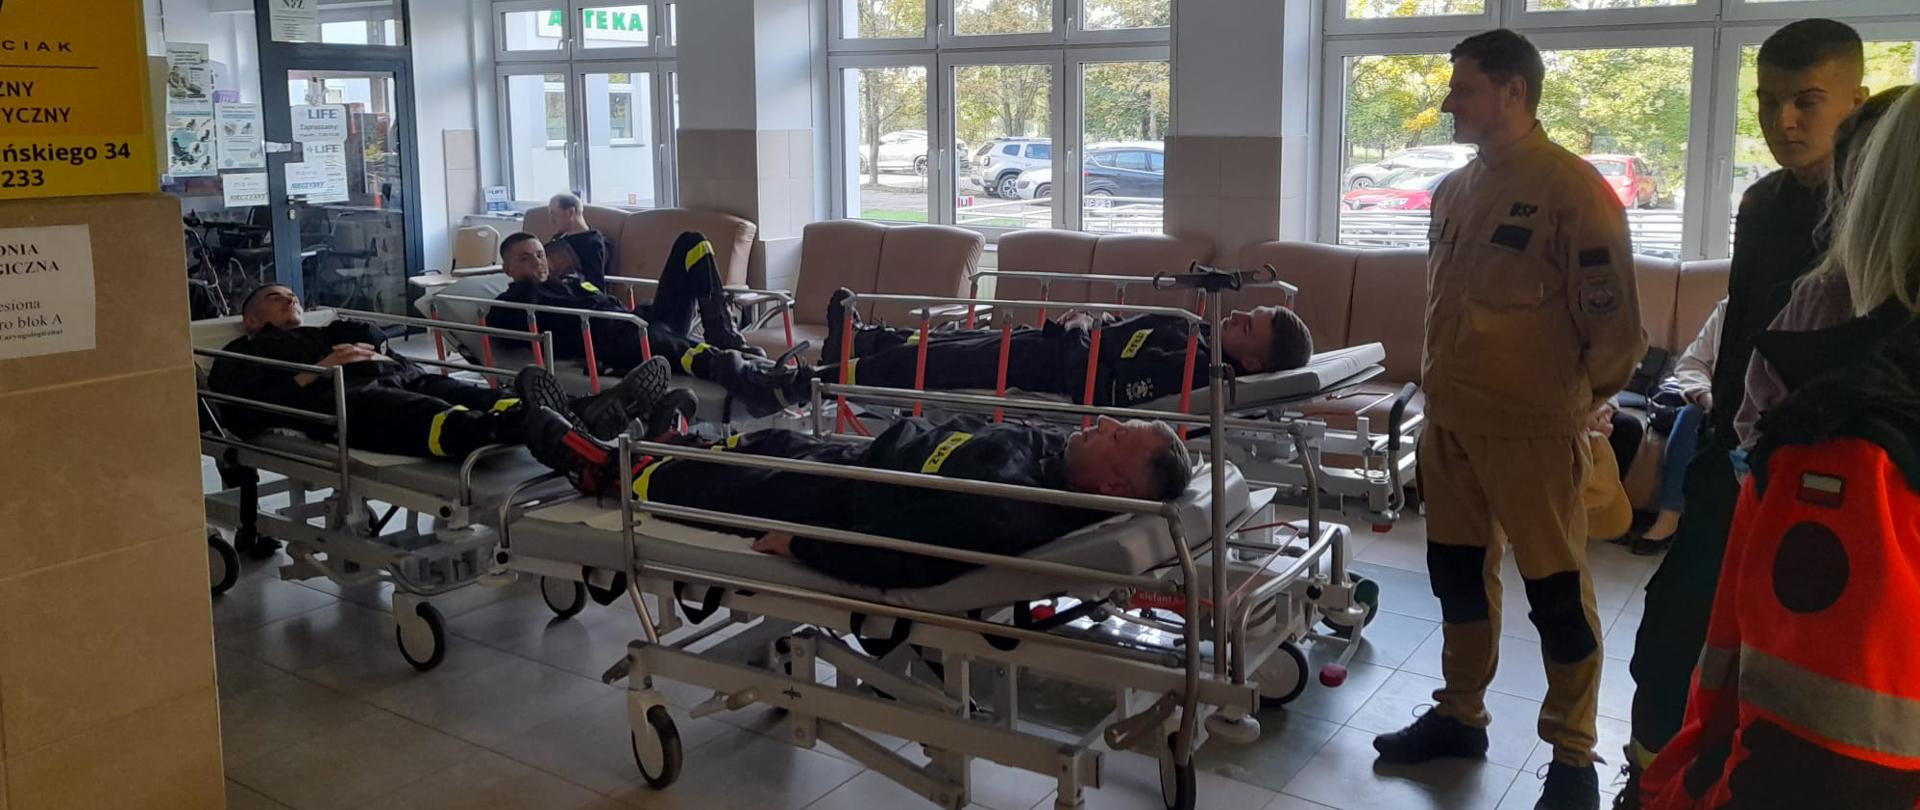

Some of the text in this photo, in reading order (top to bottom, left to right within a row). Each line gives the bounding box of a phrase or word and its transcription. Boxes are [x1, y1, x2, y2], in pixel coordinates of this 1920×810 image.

[547, 9, 644, 32] ATEKA
[1, 107, 71, 123] YCZNY
[308, 109, 339, 119] LIFE
[2, 143, 131, 166] ńskiego 34
[315, 145, 341, 153] LIFE
[1, 169, 45, 188] 233
[18, 314, 48, 329] blok
[52, 313, 62, 325] A
